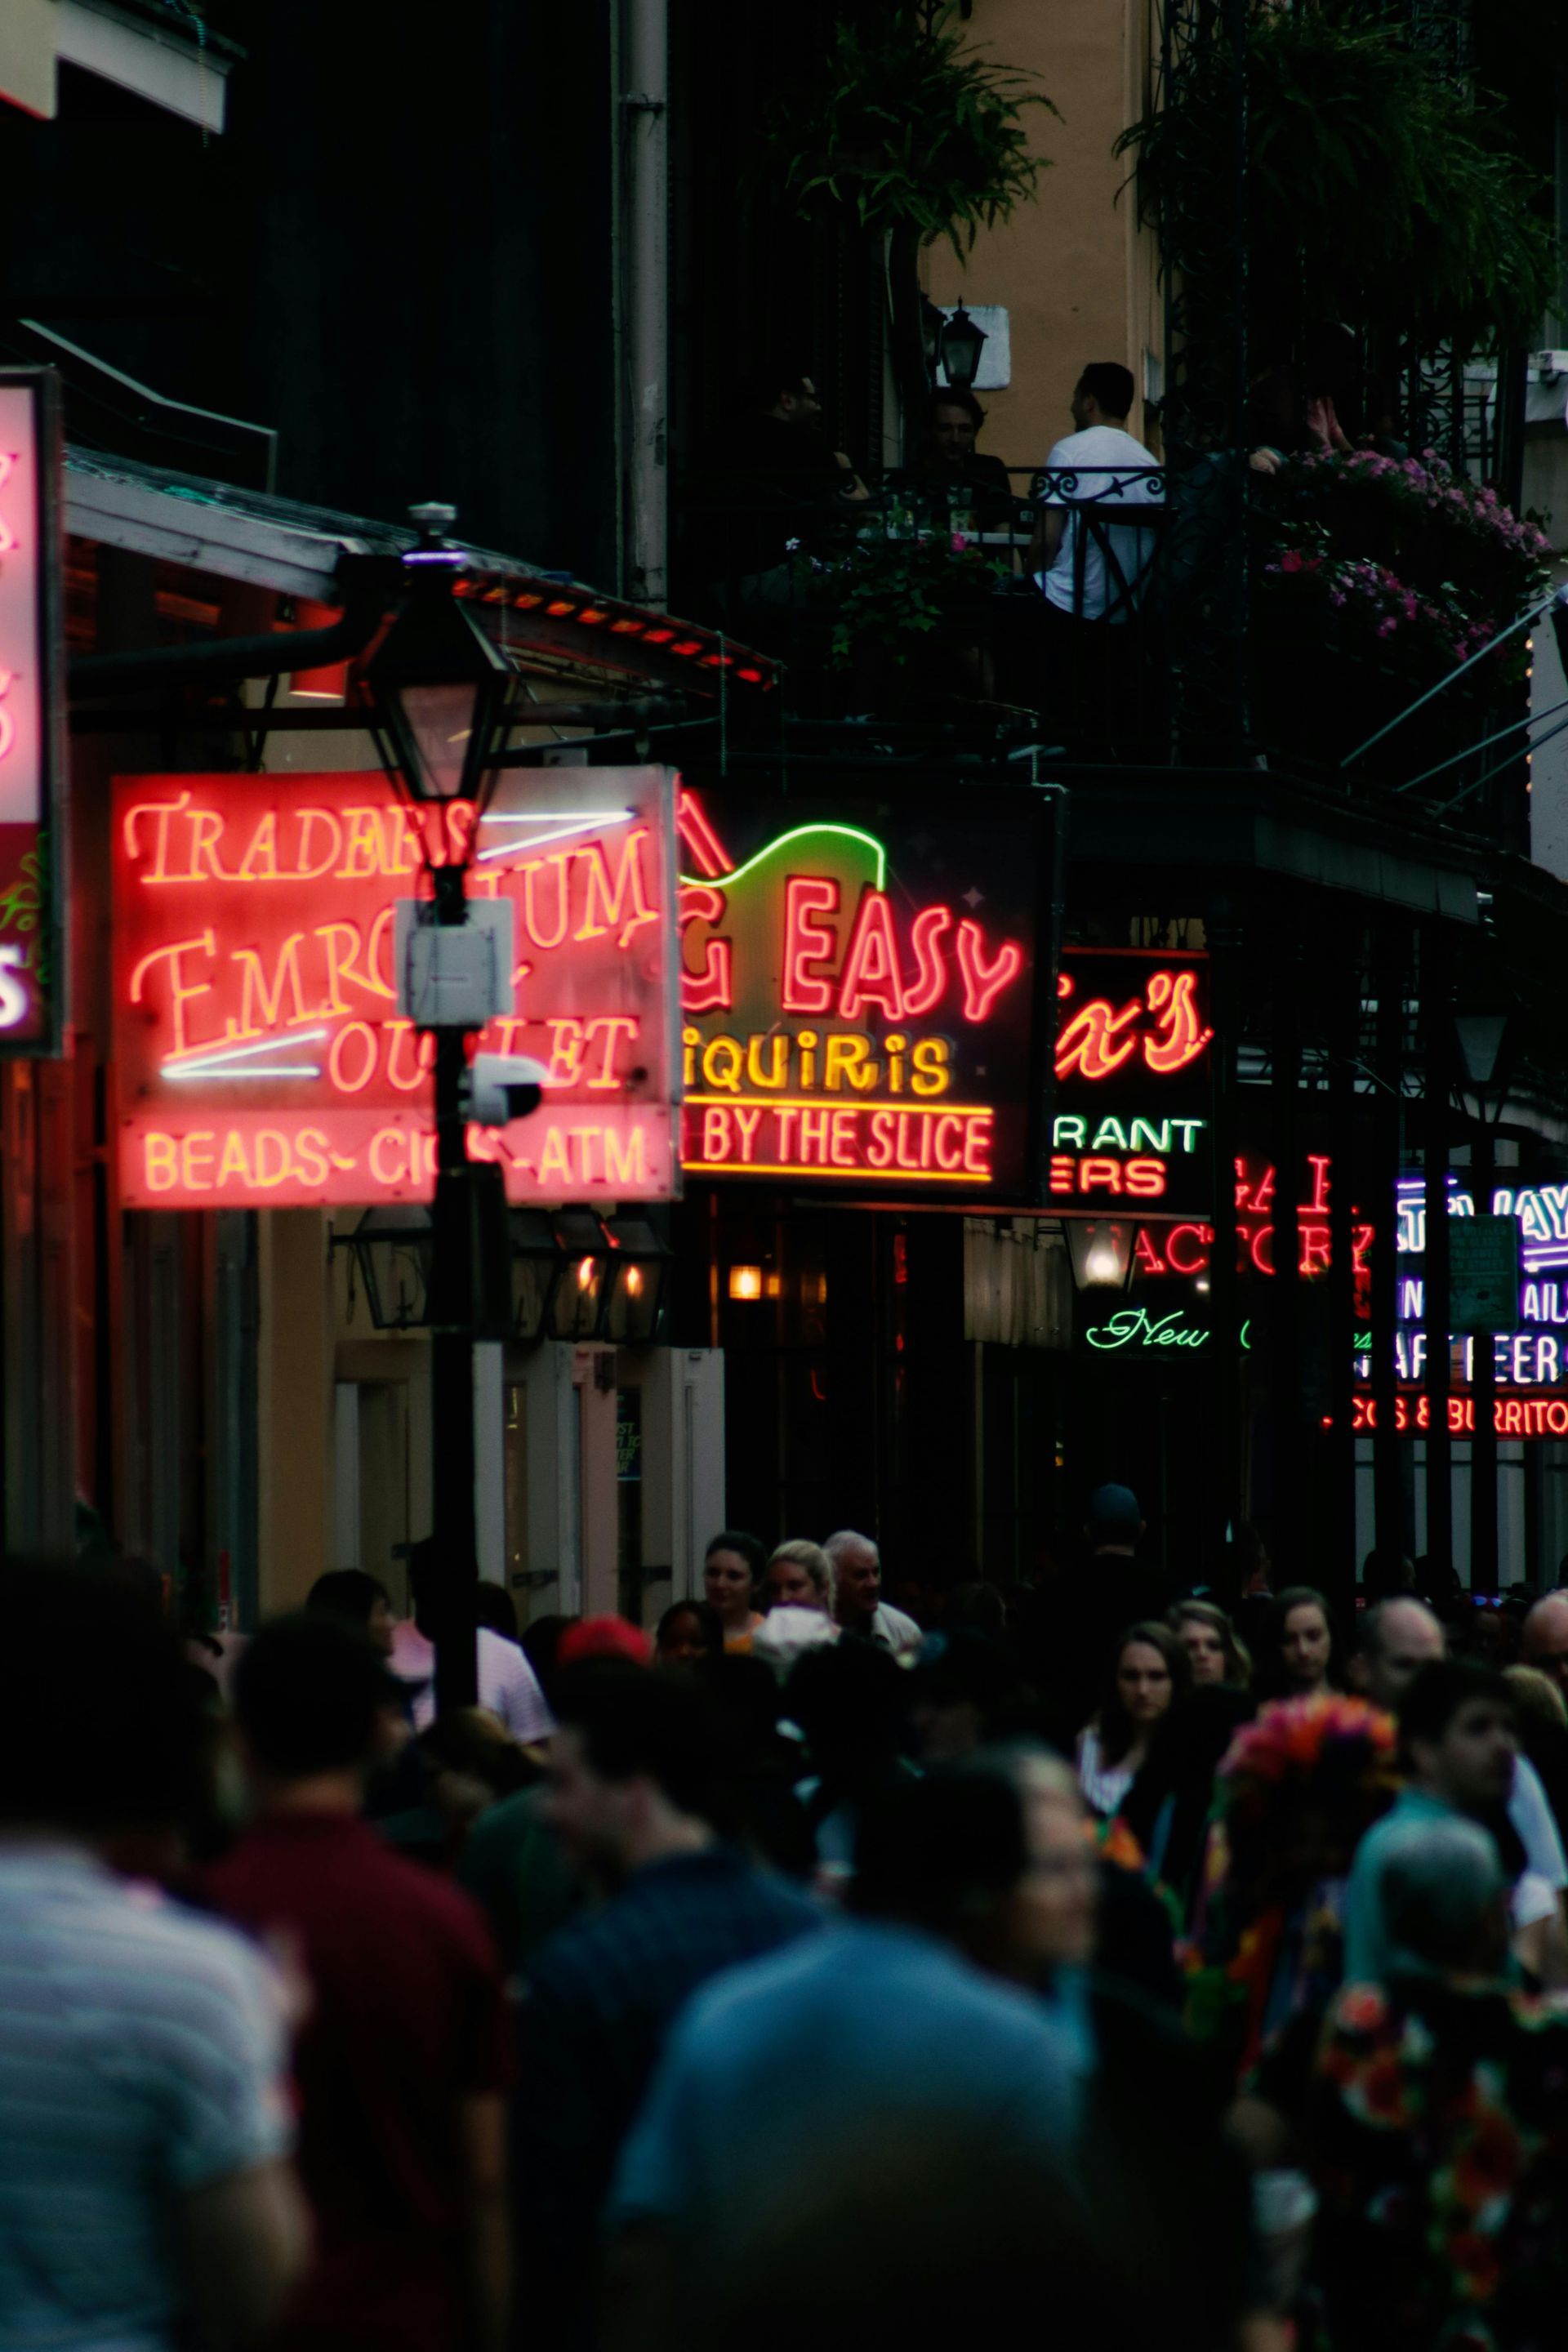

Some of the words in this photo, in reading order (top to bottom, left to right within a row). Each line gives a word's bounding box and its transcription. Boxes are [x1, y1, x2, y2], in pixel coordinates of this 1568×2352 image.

[782, 875, 1022, 1022] EASY
[703, 1107, 761, 1163] BY
[773, 1107, 857, 1165] THE
[867, 1110, 994, 1174] SLICE
